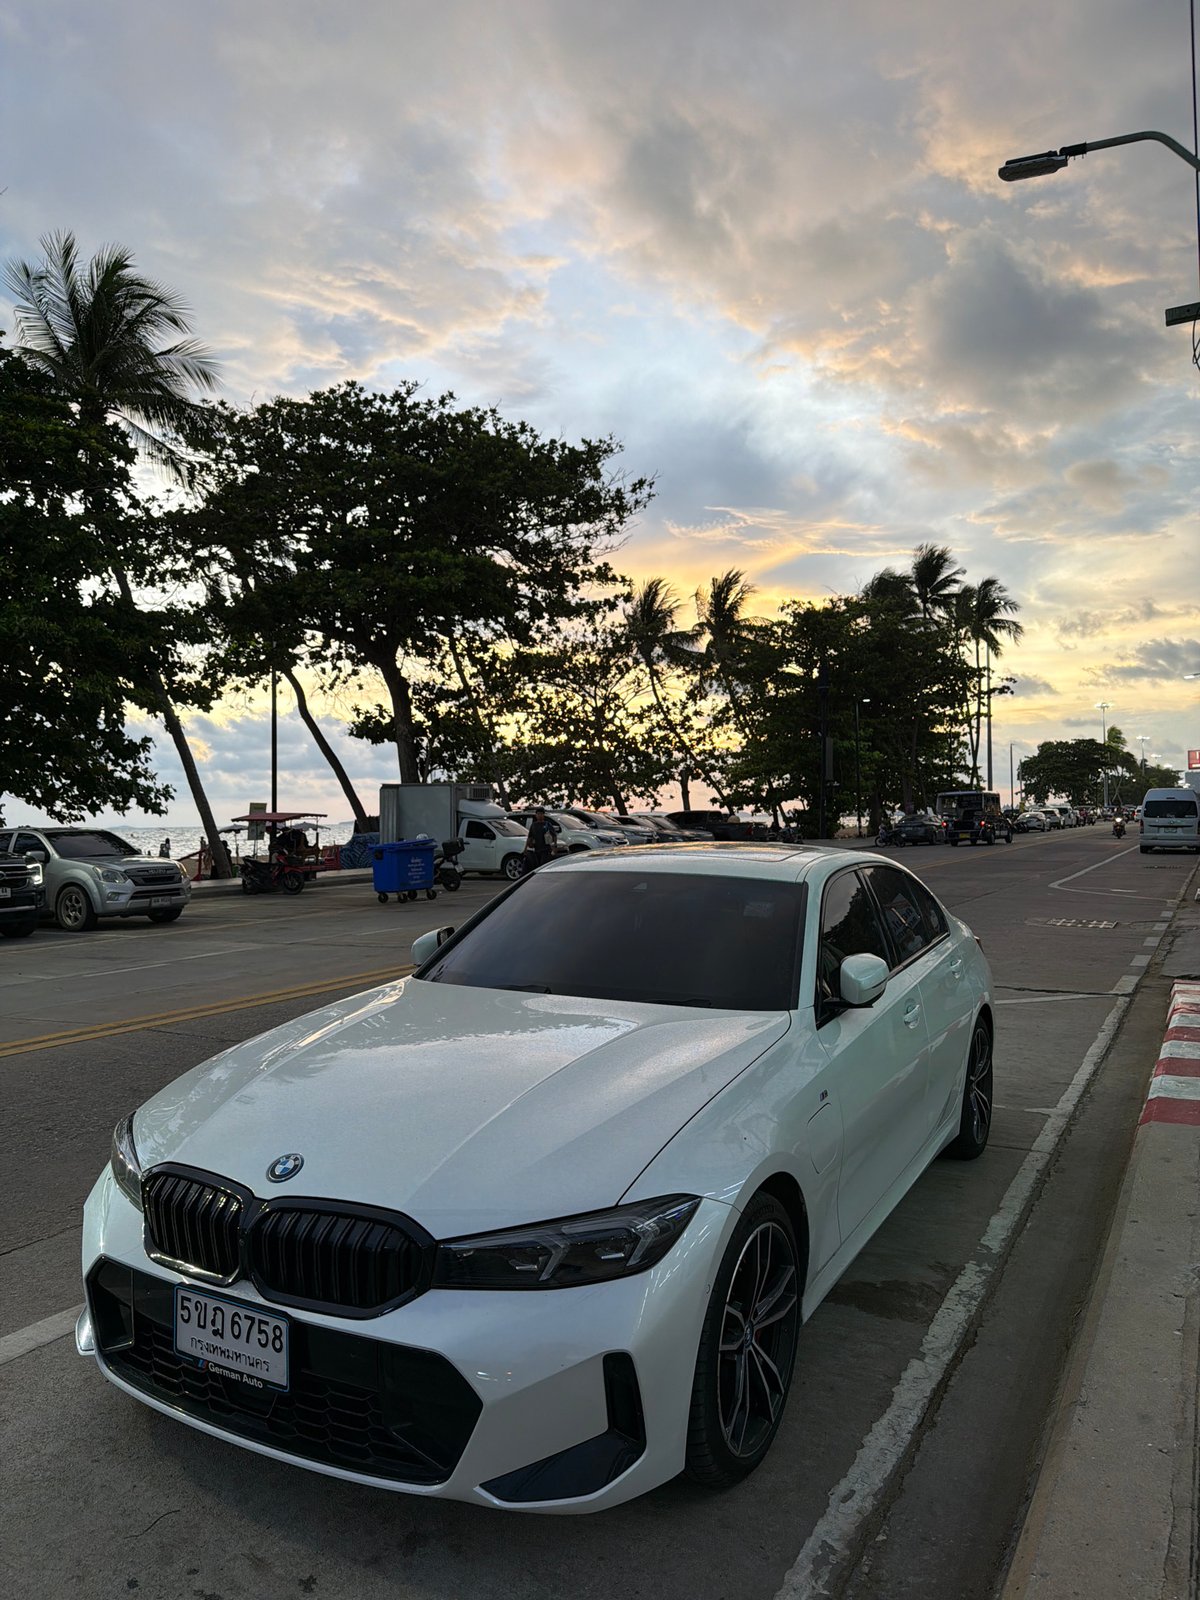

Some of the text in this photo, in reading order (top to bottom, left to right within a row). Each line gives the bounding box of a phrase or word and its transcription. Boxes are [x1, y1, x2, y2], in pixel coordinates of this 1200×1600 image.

[231, 1311, 283, 1353] 6758
[190, 1337, 270, 1372] กรุงเทพมหานคร
[208, 1362, 264, 1389] German Auto
